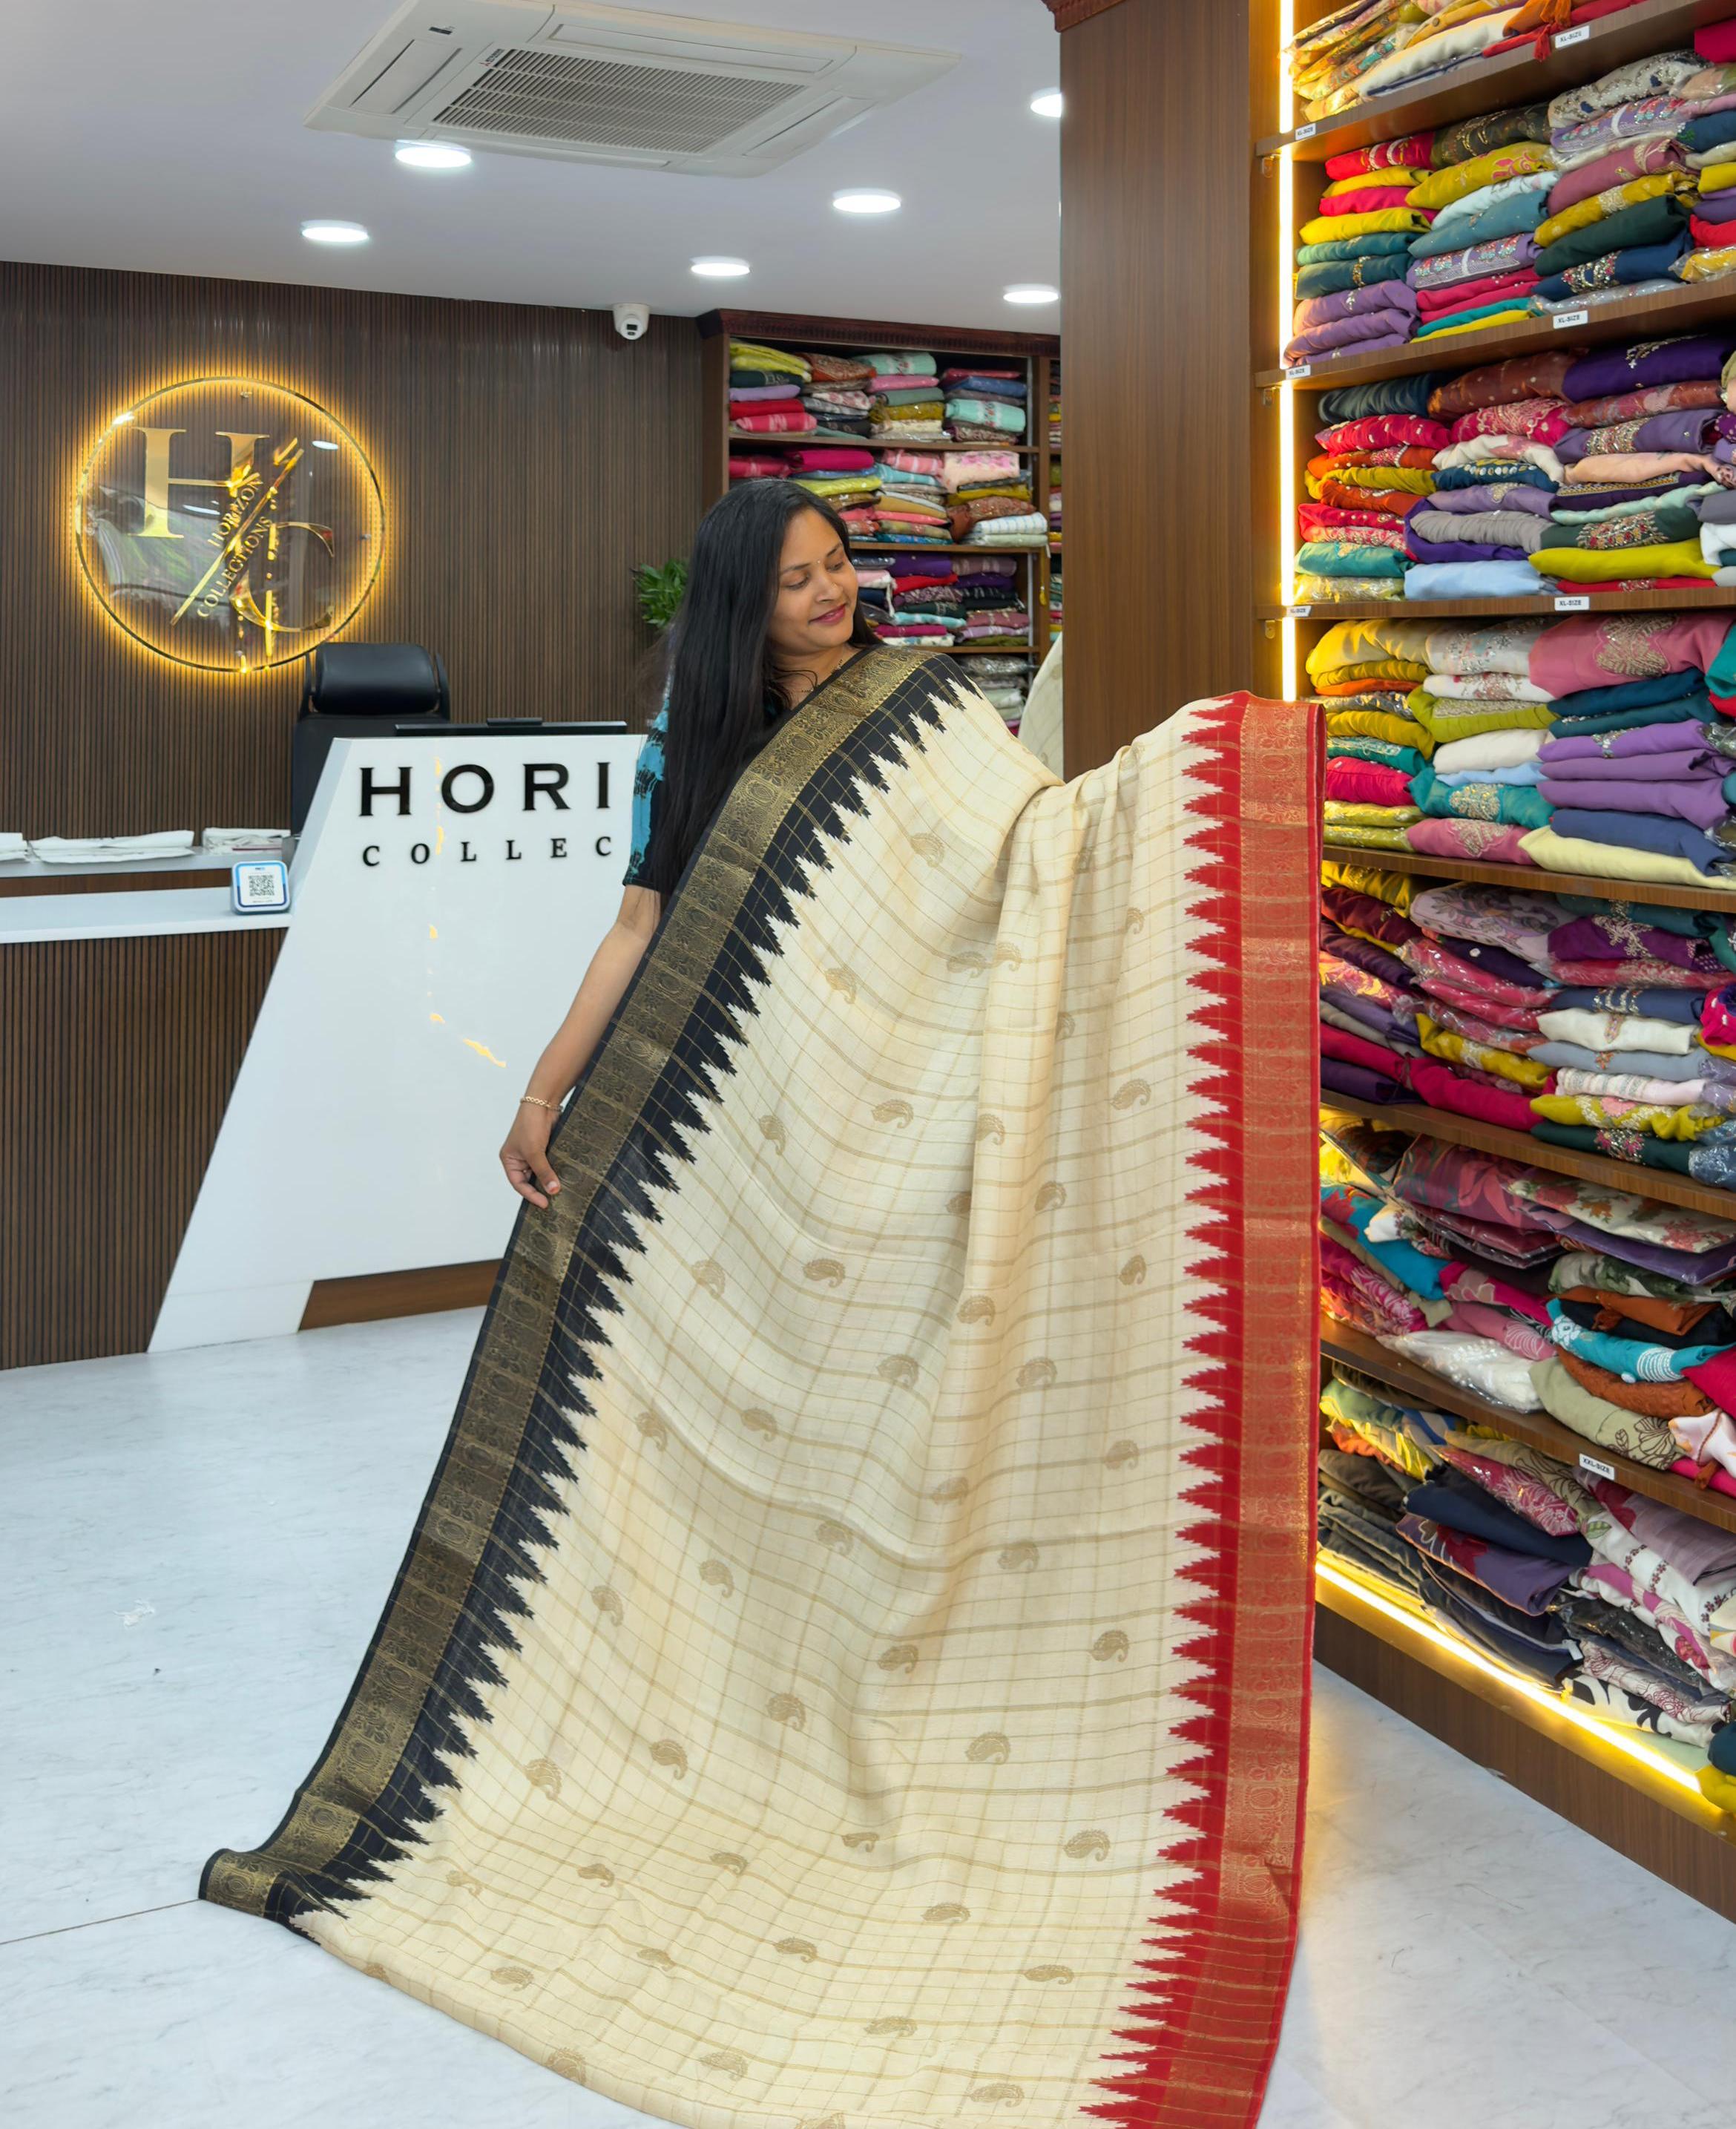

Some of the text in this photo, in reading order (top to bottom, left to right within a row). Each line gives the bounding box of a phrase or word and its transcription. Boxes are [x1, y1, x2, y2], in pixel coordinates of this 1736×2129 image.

[207, 478, 263, 548] HORIZON
[196, 516, 272, 618] COLLECTIONS
[359, 761, 611, 817] HORI
[362, 836, 611, 867] COLLEC
